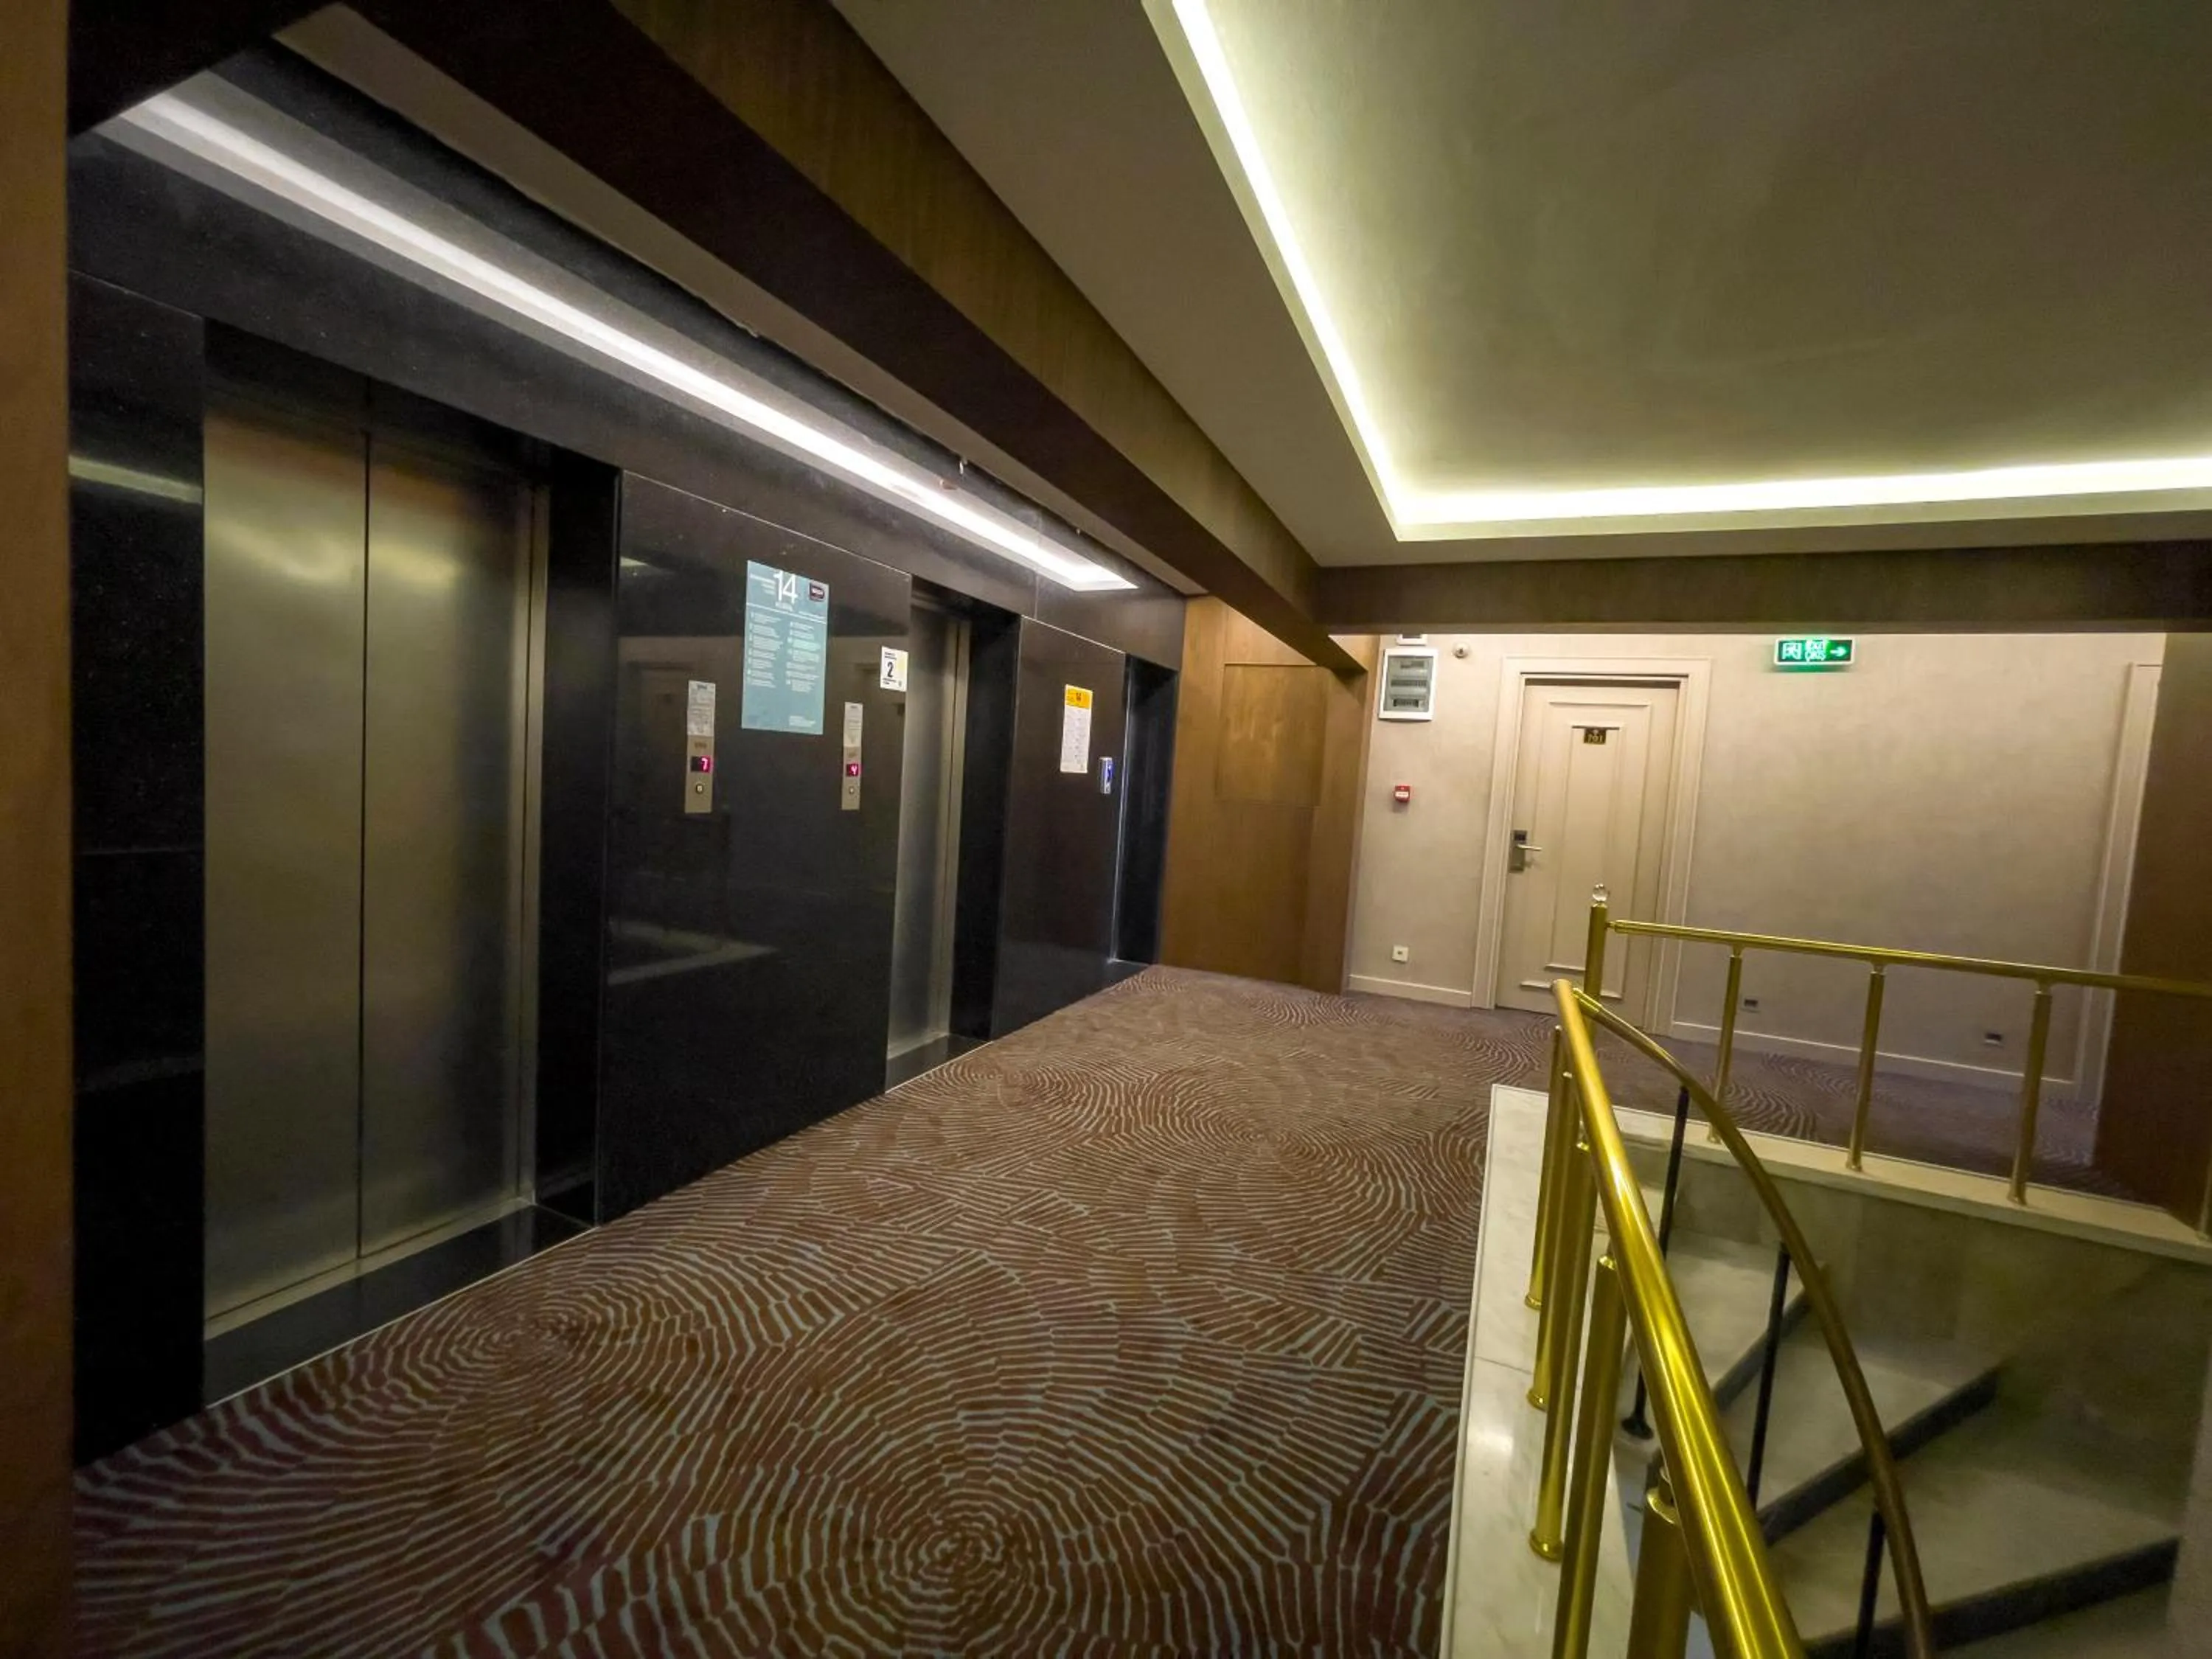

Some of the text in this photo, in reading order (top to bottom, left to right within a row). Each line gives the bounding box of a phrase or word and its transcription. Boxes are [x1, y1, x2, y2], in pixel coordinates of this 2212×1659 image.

[773, 571, 799, 604] 14
[887, 661, 894, 678] 2
[701, 757, 709, 771] 7
